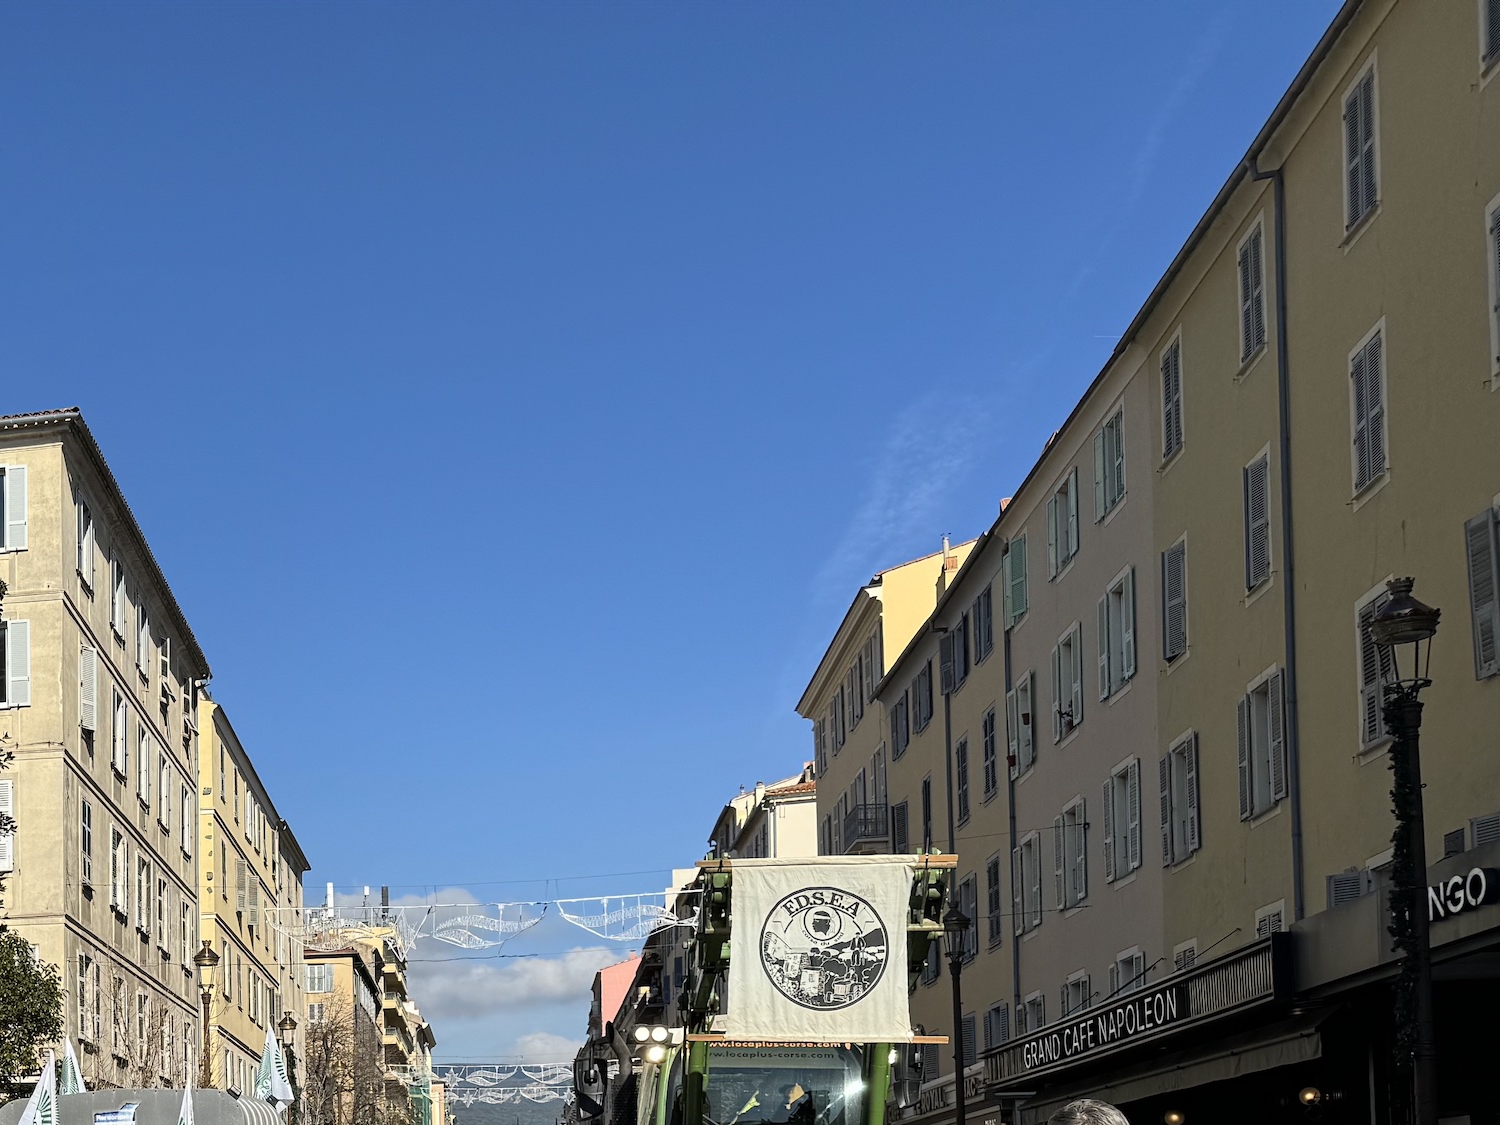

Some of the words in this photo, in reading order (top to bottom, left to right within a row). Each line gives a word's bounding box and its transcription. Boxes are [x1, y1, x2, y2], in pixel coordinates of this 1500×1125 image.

[1427, 867, 1486, 922] NGO
[1023, 1033, 1061, 1069] GRAND
[1063, 1019, 1096, 1056] CAFE
[1098, 987, 1178, 1045] NAPOLEON
